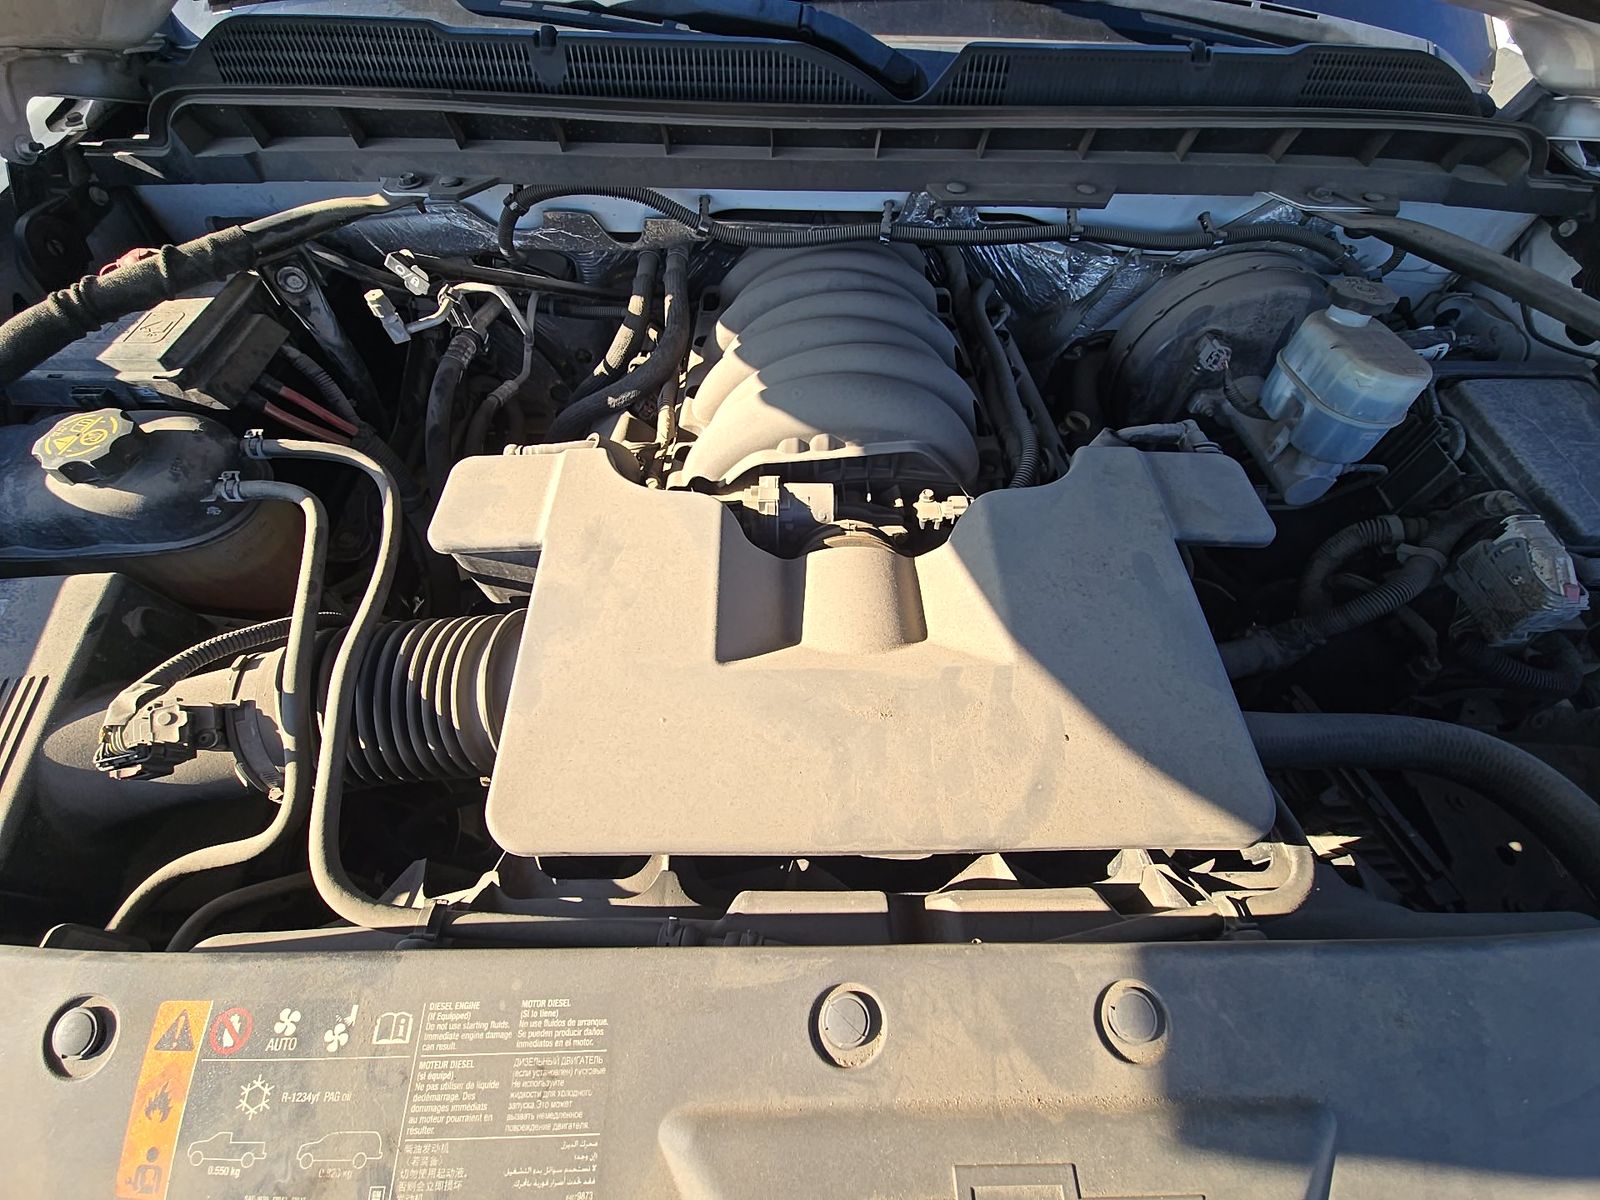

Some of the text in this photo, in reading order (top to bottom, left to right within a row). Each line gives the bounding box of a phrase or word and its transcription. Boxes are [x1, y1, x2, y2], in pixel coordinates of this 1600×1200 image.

[429, 1002, 480, 1010] DIESEL ENGINE
[522, 999, 571, 1008] MOTOR DIESEL
[437, 1012, 471, 1021] Equipped)
[437, 1022, 448, 1030] not
[462, 1022, 488, 1031] starting
[567, 1018, 575, 1026] de
[461, 1032, 484, 1041] engine
[485, 1031, 512, 1040] damage
[517, 1030, 526, 1038] Se
[528, 1030, 553, 1038] pueden
[554, 1029, 582, 1038] producir
[265, 1038, 298, 1051] AUTO
[419, 1060, 475, 1070] MOTEUR DIESEL
[513, 1056, 603, 1068] ДИЗЕЛЬНЫЙ ДВИГАТЕЛЬ
[426, 1083, 439, 1092] pas
[466, 1081, 474, 1089] de
[476, 1080, 500, 1091] liquide
[281, 1092, 320, 1104] R-1234yf
[324, 1091, 340, 1101] PAG
[462, 1092, 475, 1100] Des
[410, 1104, 449, 1114] dommages
[408, 1114, 493, 1124] au moteur pourraient en
[230, 1166, 241, 1179] kg
